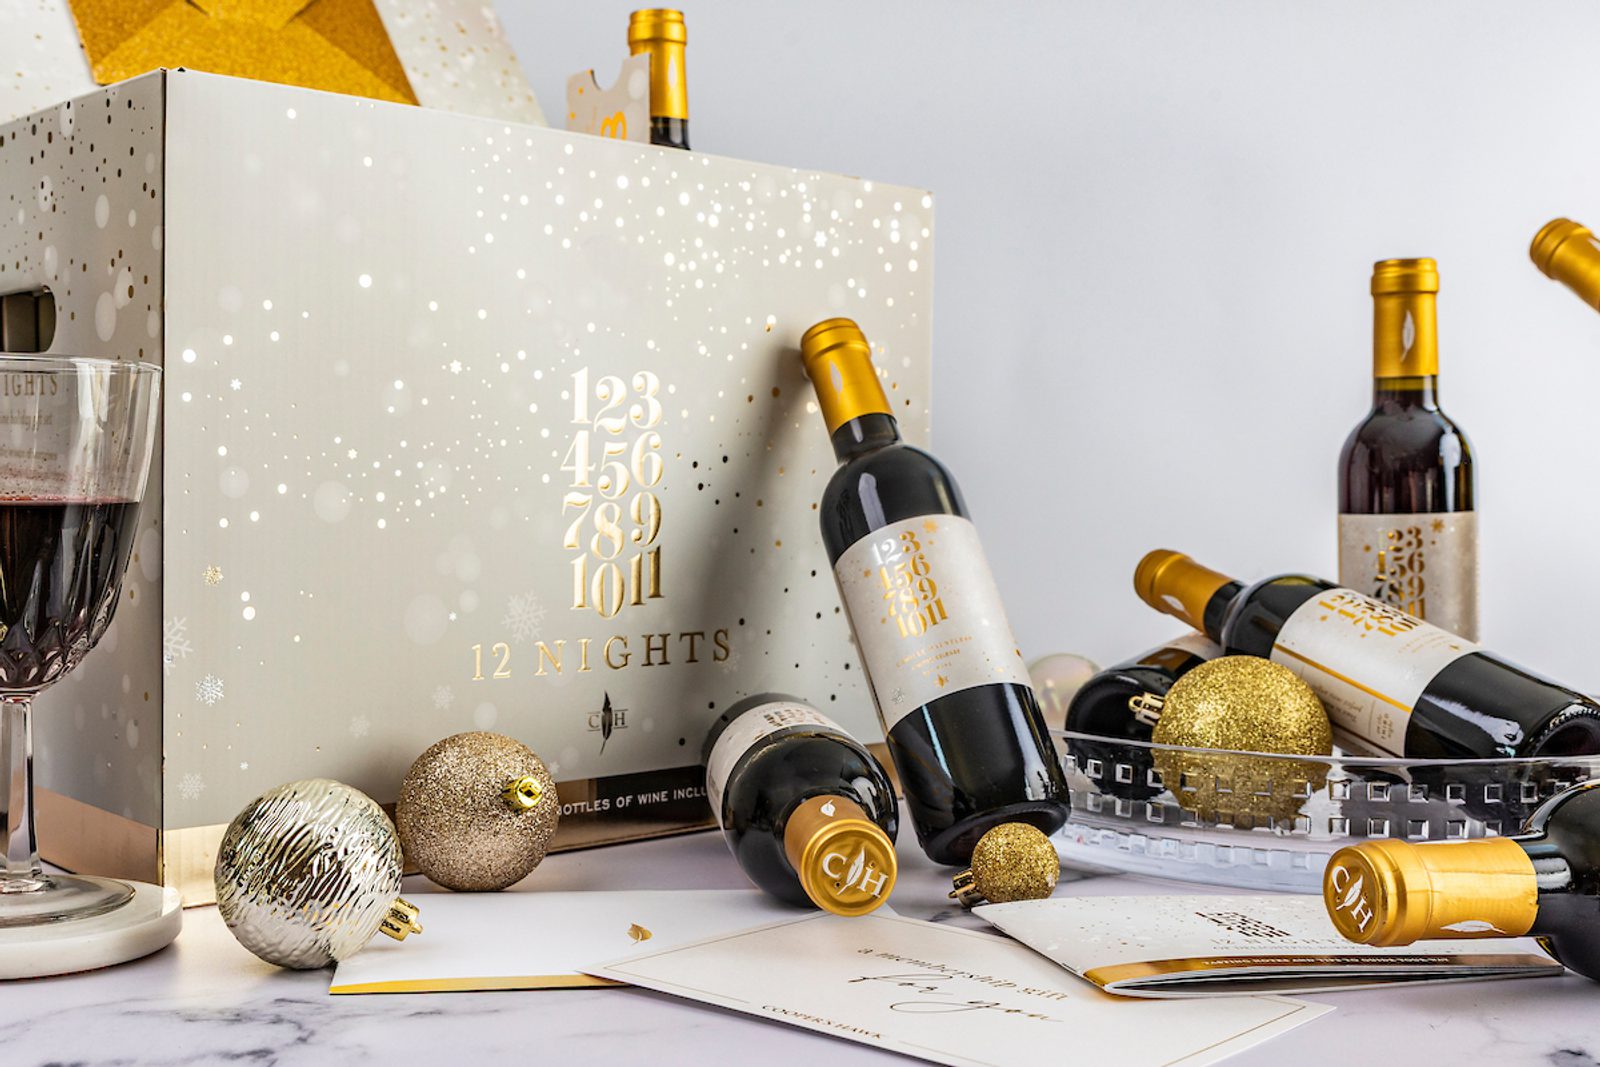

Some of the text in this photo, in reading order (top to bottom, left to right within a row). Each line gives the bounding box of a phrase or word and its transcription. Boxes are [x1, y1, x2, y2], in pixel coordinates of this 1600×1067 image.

[570, 366, 662, 435] 123
[560, 430, 663, 500] 456
[561, 491, 662, 561] 789
[471, 628, 732, 681] 12 NIGHTS
[616, 795, 633, 808] OF
[637, 790, 668, 805] WINE
